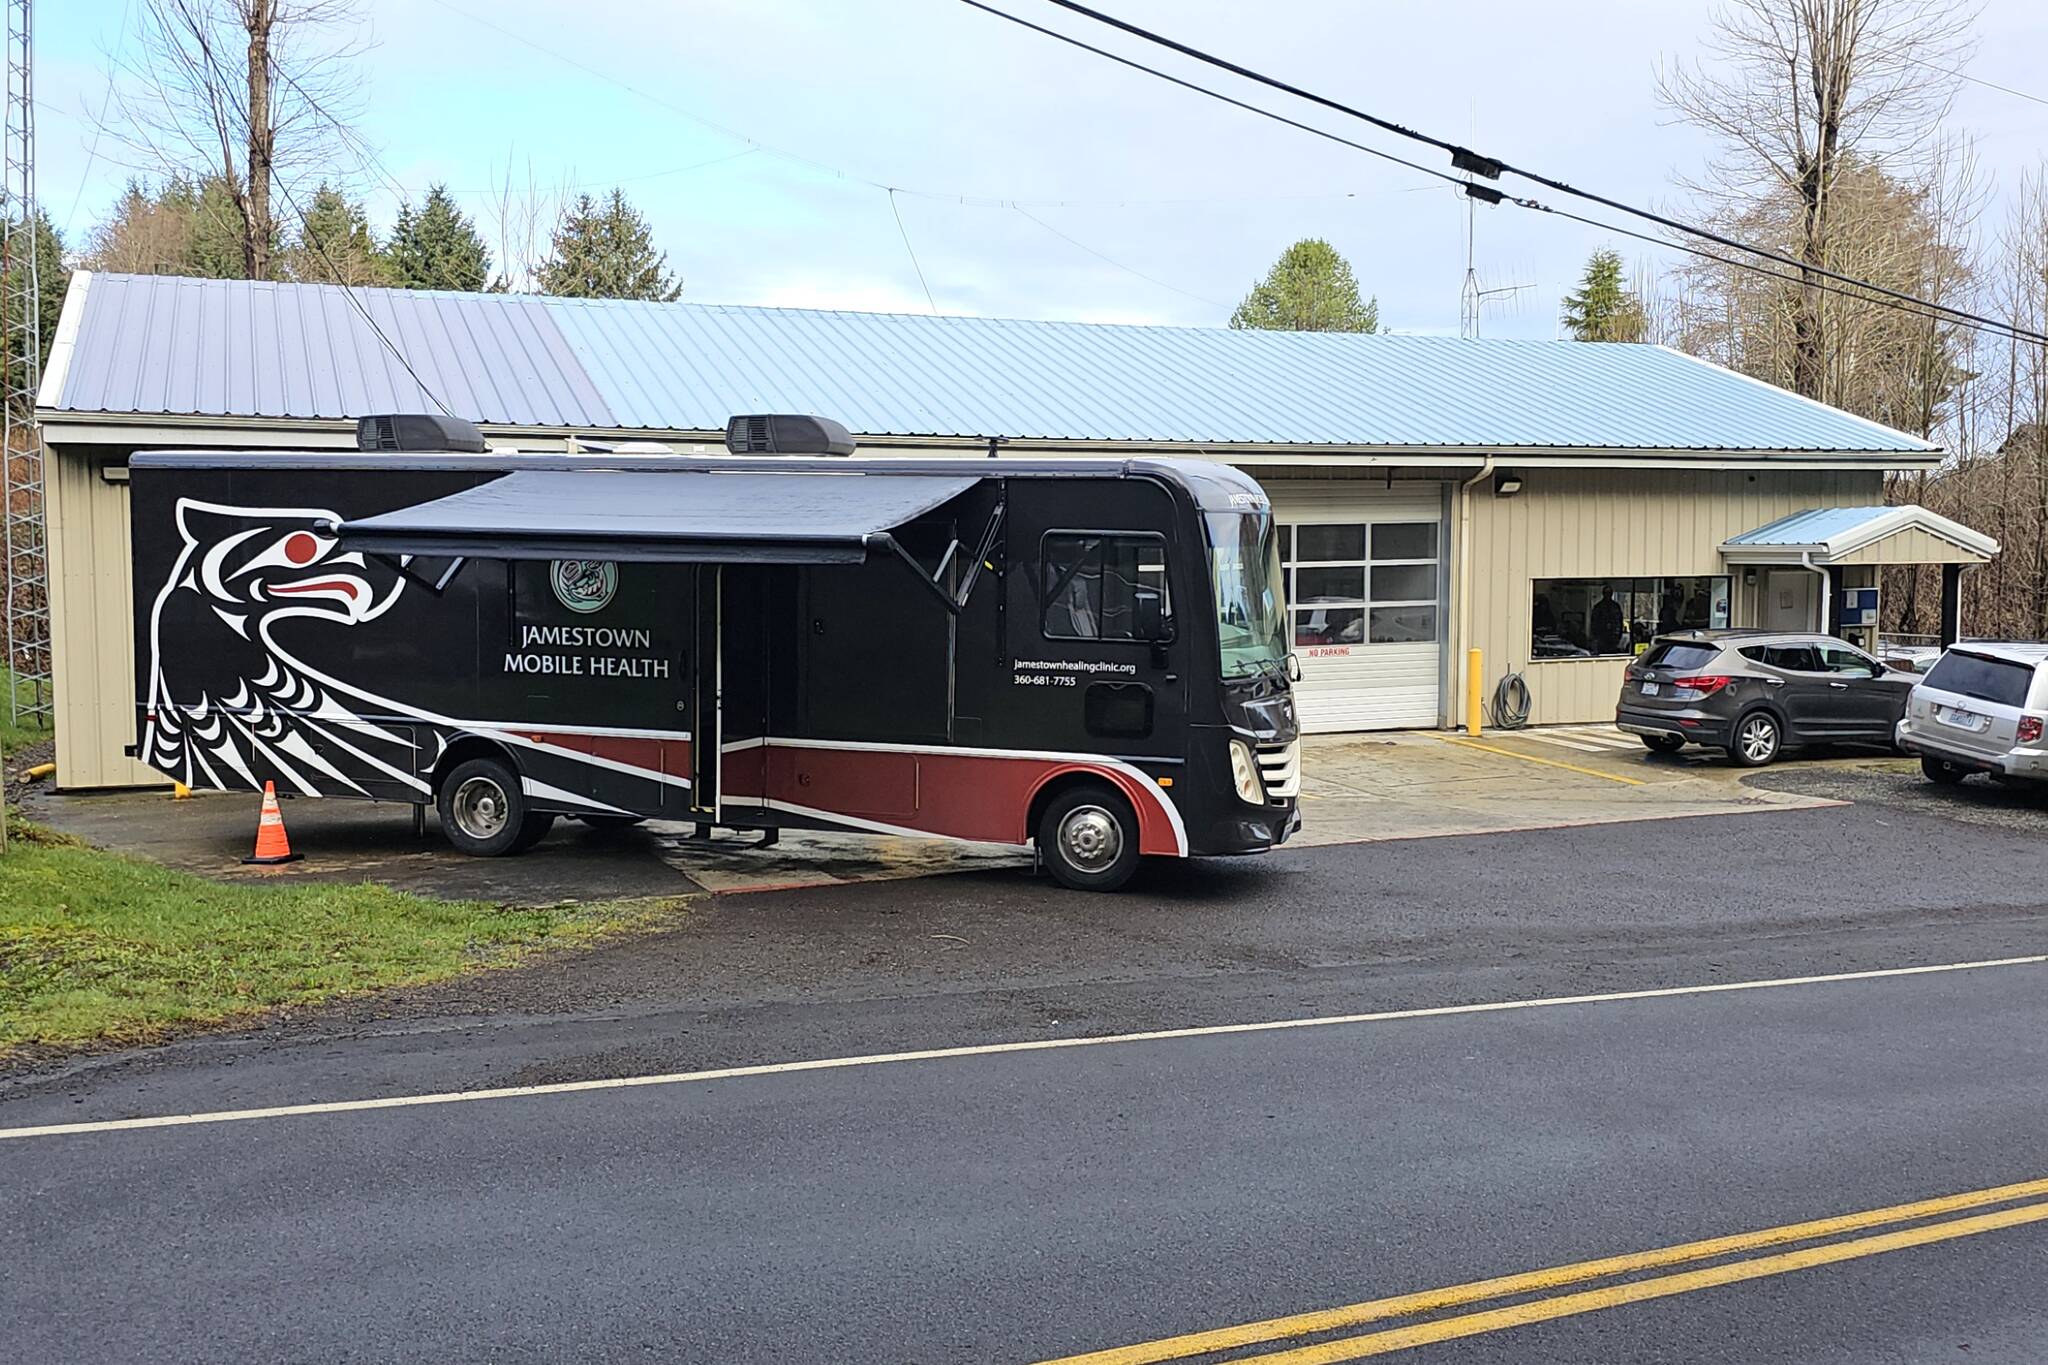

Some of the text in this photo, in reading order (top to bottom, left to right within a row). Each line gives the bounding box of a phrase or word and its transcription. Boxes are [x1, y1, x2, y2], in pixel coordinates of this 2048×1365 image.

[521, 625, 650, 649] JAMESTOWN
[1309, 647, 1350, 657] NO PARKING
[504, 653, 669, 679] MOBILE HEALTH
[1013, 674, 1076, 686] 360-681-7755
